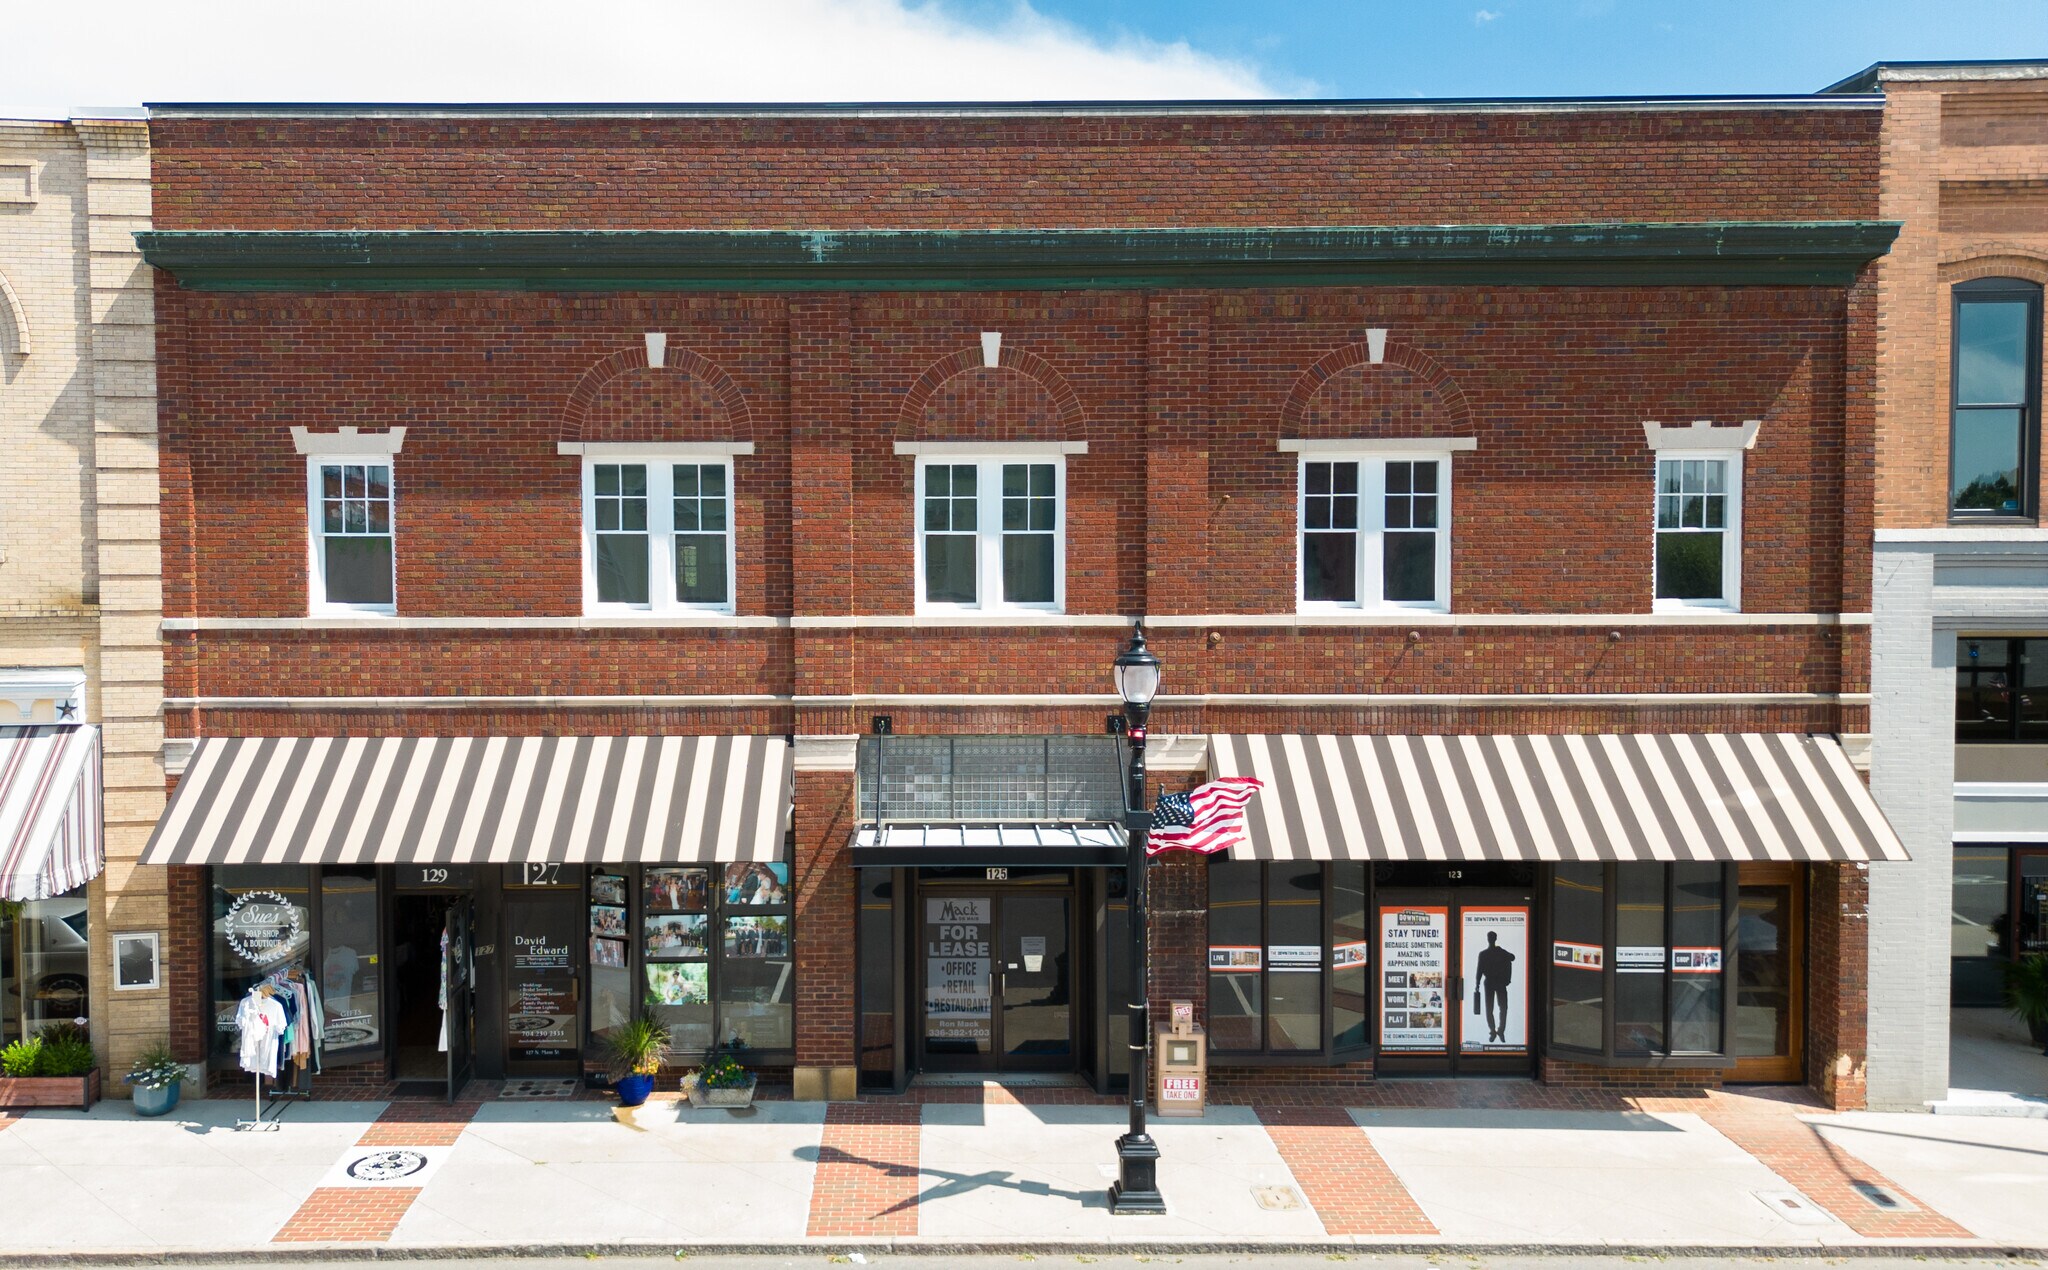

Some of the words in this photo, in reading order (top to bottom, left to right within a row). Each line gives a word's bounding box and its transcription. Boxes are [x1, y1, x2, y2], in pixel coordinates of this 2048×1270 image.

[422, 868, 448, 883] 129
[523, 862, 561, 885] 127
[988, 868, 1007, 879] 125
[1448, 870, 1462, 878] 123
[241, 904, 280, 924] Sue's
[939, 901, 979, 921] Mack
[245, 930, 261, 938] SOAP
[262, 930, 280, 938] SHOP
[940, 925, 978, 940] FOR
[1388, 930, 1408, 938] STAY
[1411, 930, 1439, 938] TUNED!
[250, 940, 282, 948] BOUTIQUE
[515, 936, 546, 945] David
[530, 945, 568, 955] Edward
[928, 942, 990, 957] LEASE
[946, 962, 976, 976] OFFICE
[1388, 976, 1404, 984] MEET
[947, 980, 976, 994] RETAIL
[1387, 996, 1405, 1004] WORK
[934, 998, 990, 1013] RESTAURANT
[340, 1009, 362, 1018] GIFTS
[1175, 1006, 1191, 1016] FREE
[332, 1020, 350, 1028] SKIN
[351, 1018, 371, 1026] CARE
[1388, 1016, 1404, 1024] PLAY
[928, 1029, 990, 1037] 336-382-1203
[1166, 1080, 1197, 1089] FREE
[1166, 1090, 1182, 1098] TAKE
[1184, 1090, 1196, 1099] ONE
